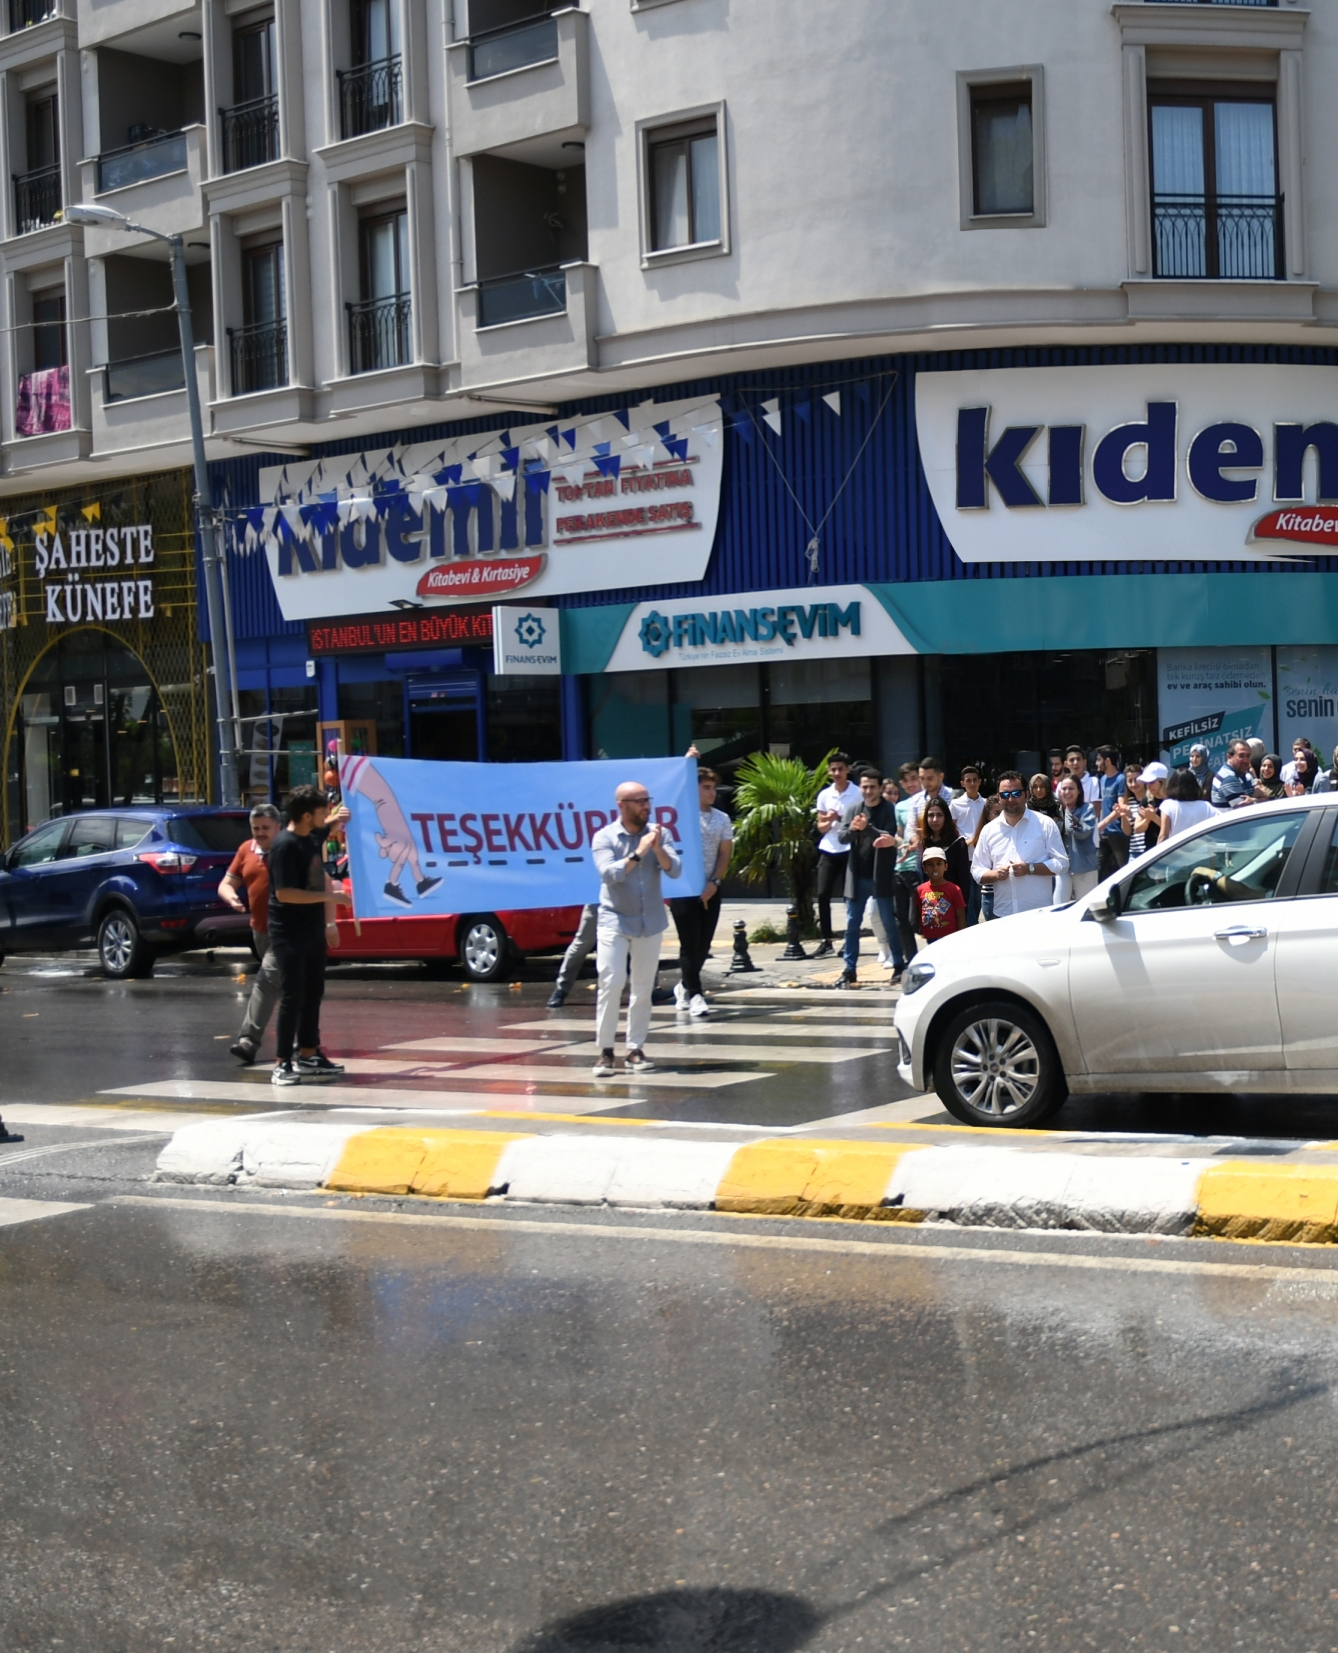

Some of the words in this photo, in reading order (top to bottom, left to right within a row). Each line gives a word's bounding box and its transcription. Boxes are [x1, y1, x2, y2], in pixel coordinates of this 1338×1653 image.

[556, 506, 645, 534] PERAKENDE
[648, 501, 693, 523] SATIŞ
[35, 525, 154, 578] ŞAHESTE
[427, 569, 472, 588] Kitabevi
[472, 567, 481, 583] &
[481, 563, 531, 583] Kırtasiye
[45, 573, 154, 622] KÜNEFE
[399, 621, 418, 643] EN
[420, 614, 470, 642] BÜYÜK
[1166, 663, 1193, 671] Banka
[1194, 662, 1222, 671] kredisi
[1223, 662, 1260, 671] olmadan
[1167, 672, 1180, 681] tek
[1181, 672, 1205, 682] kuruş
[1206, 671, 1220, 680] faiz
[1167, 682, 1178, 690] ev
[1180, 682, 1191, 690] ve
[1193, 682, 1212, 691] araç
[1214, 680, 1242, 689] sahibi
[1243, 680, 1267, 689] olun.
[1286, 696, 1335, 718] senin
[1169, 717, 1219, 741] KEFİLSİZ
[1173, 725, 1253, 760] PEİNATSIZ
[411, 802, 682, 865] TEŞEKKÜRR
